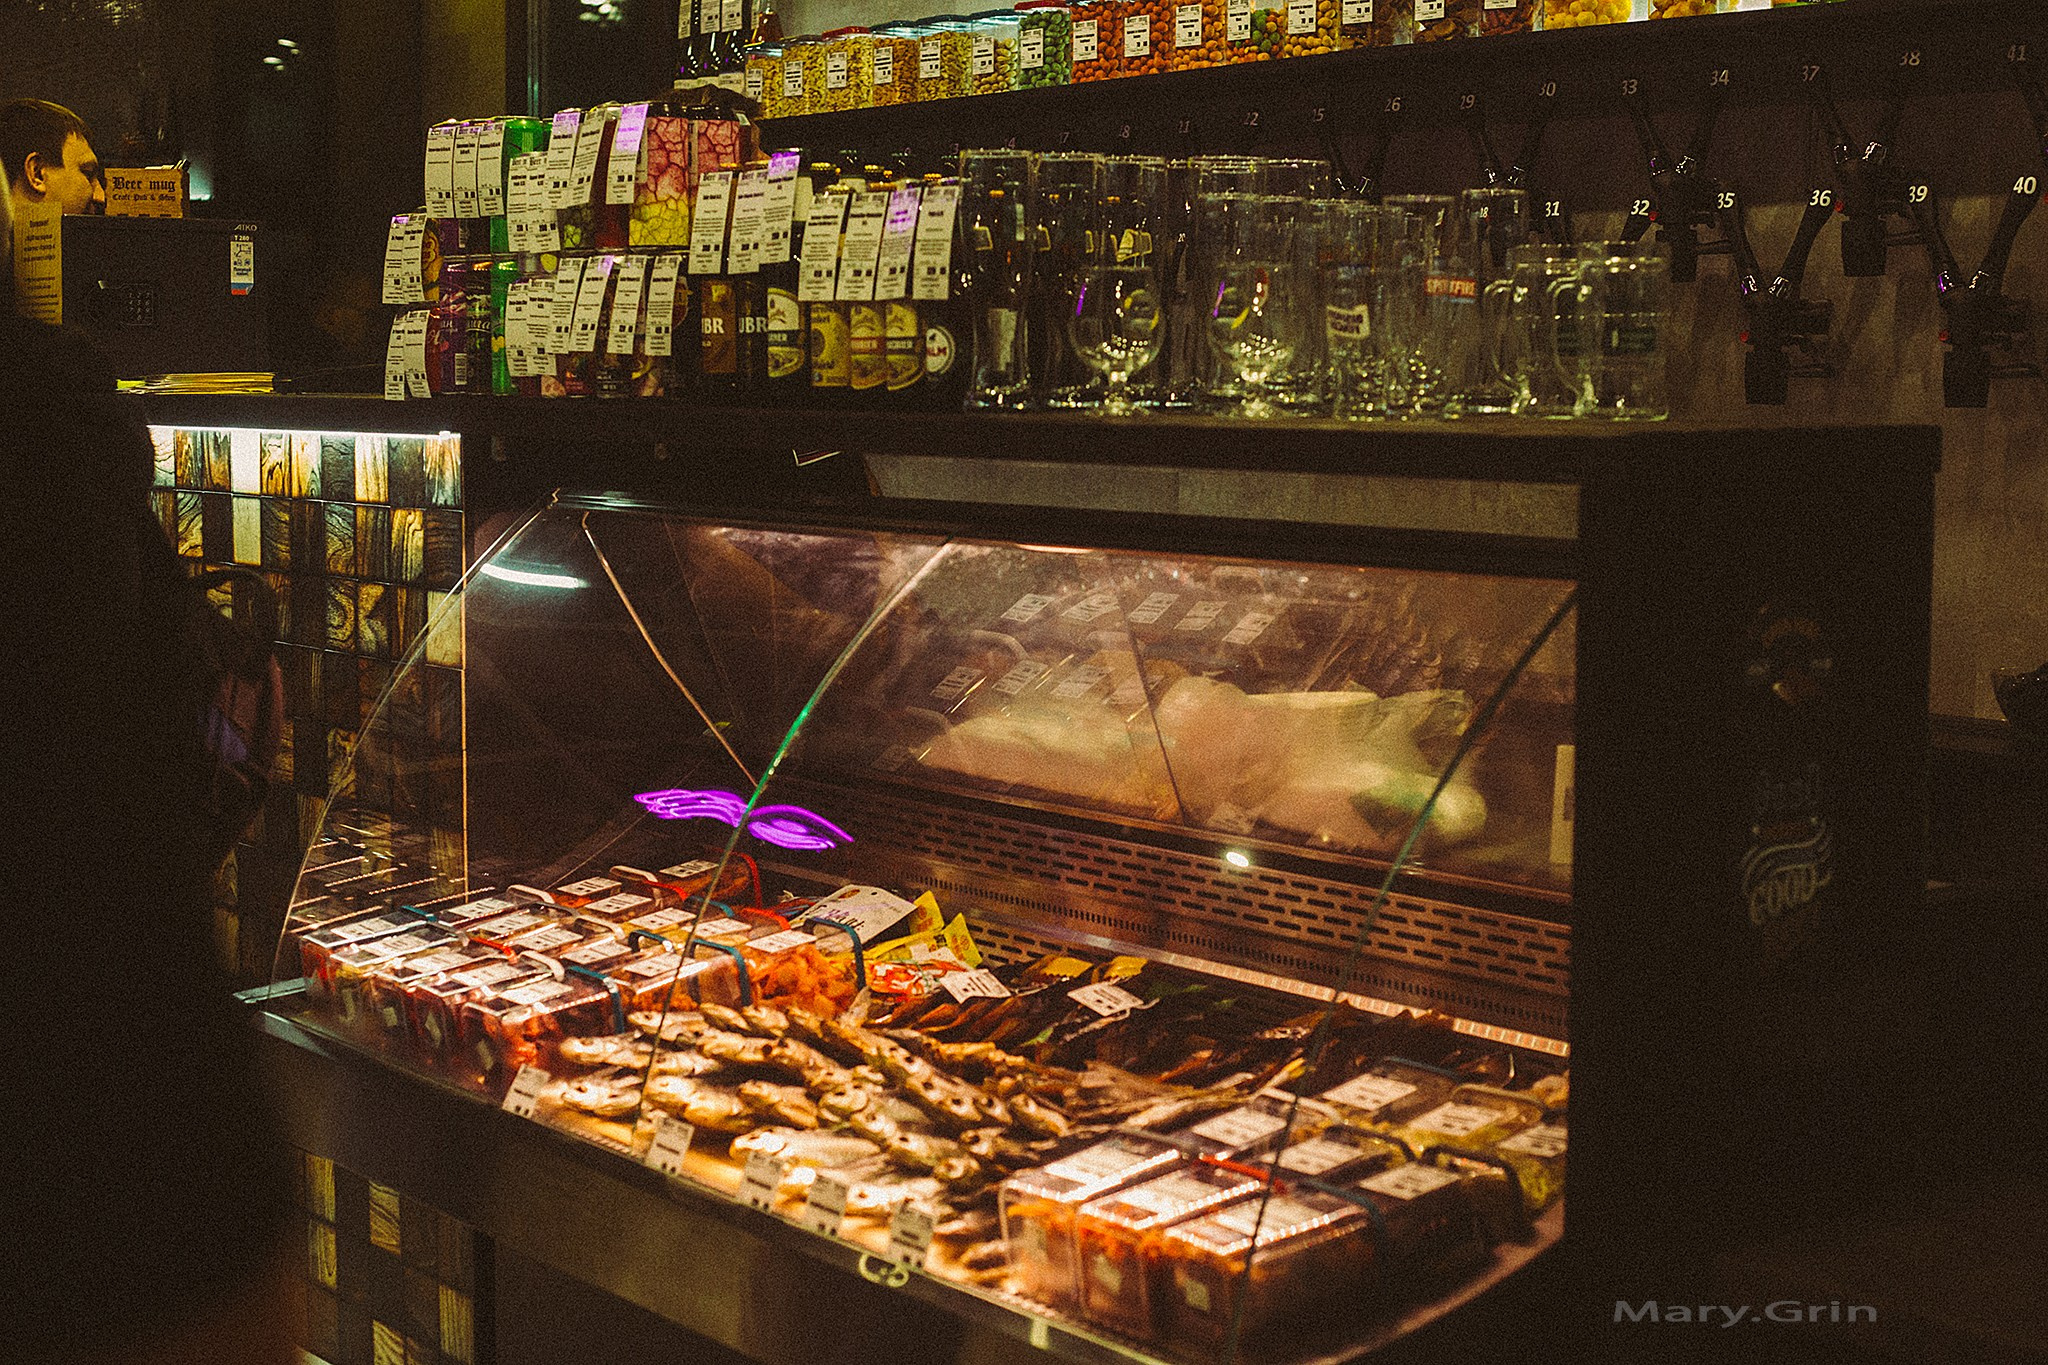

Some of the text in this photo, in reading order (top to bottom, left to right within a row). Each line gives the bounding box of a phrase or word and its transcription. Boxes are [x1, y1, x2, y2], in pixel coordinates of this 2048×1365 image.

[1899, 51, 1921, 66] 38
[1710, 68, 1730, 86] 34
[1802, 65, 1820, 82] 37
[1538, 81, 1557, 97] 30
[1621, 79, 1638, 96] 33
[112, 176, 176, 192] Beer mug
[2013, 176, 2037, 194] 40
[1717, 192, 1735, 210] 35
[1809, 189, 1832, 206] 36
[1908, 185, 1929, 203] 39
[1545, 201, 1560, 217] 31
[1630, 200, 1650, 216] 32
[234, 224, 257, 232] AIKO
